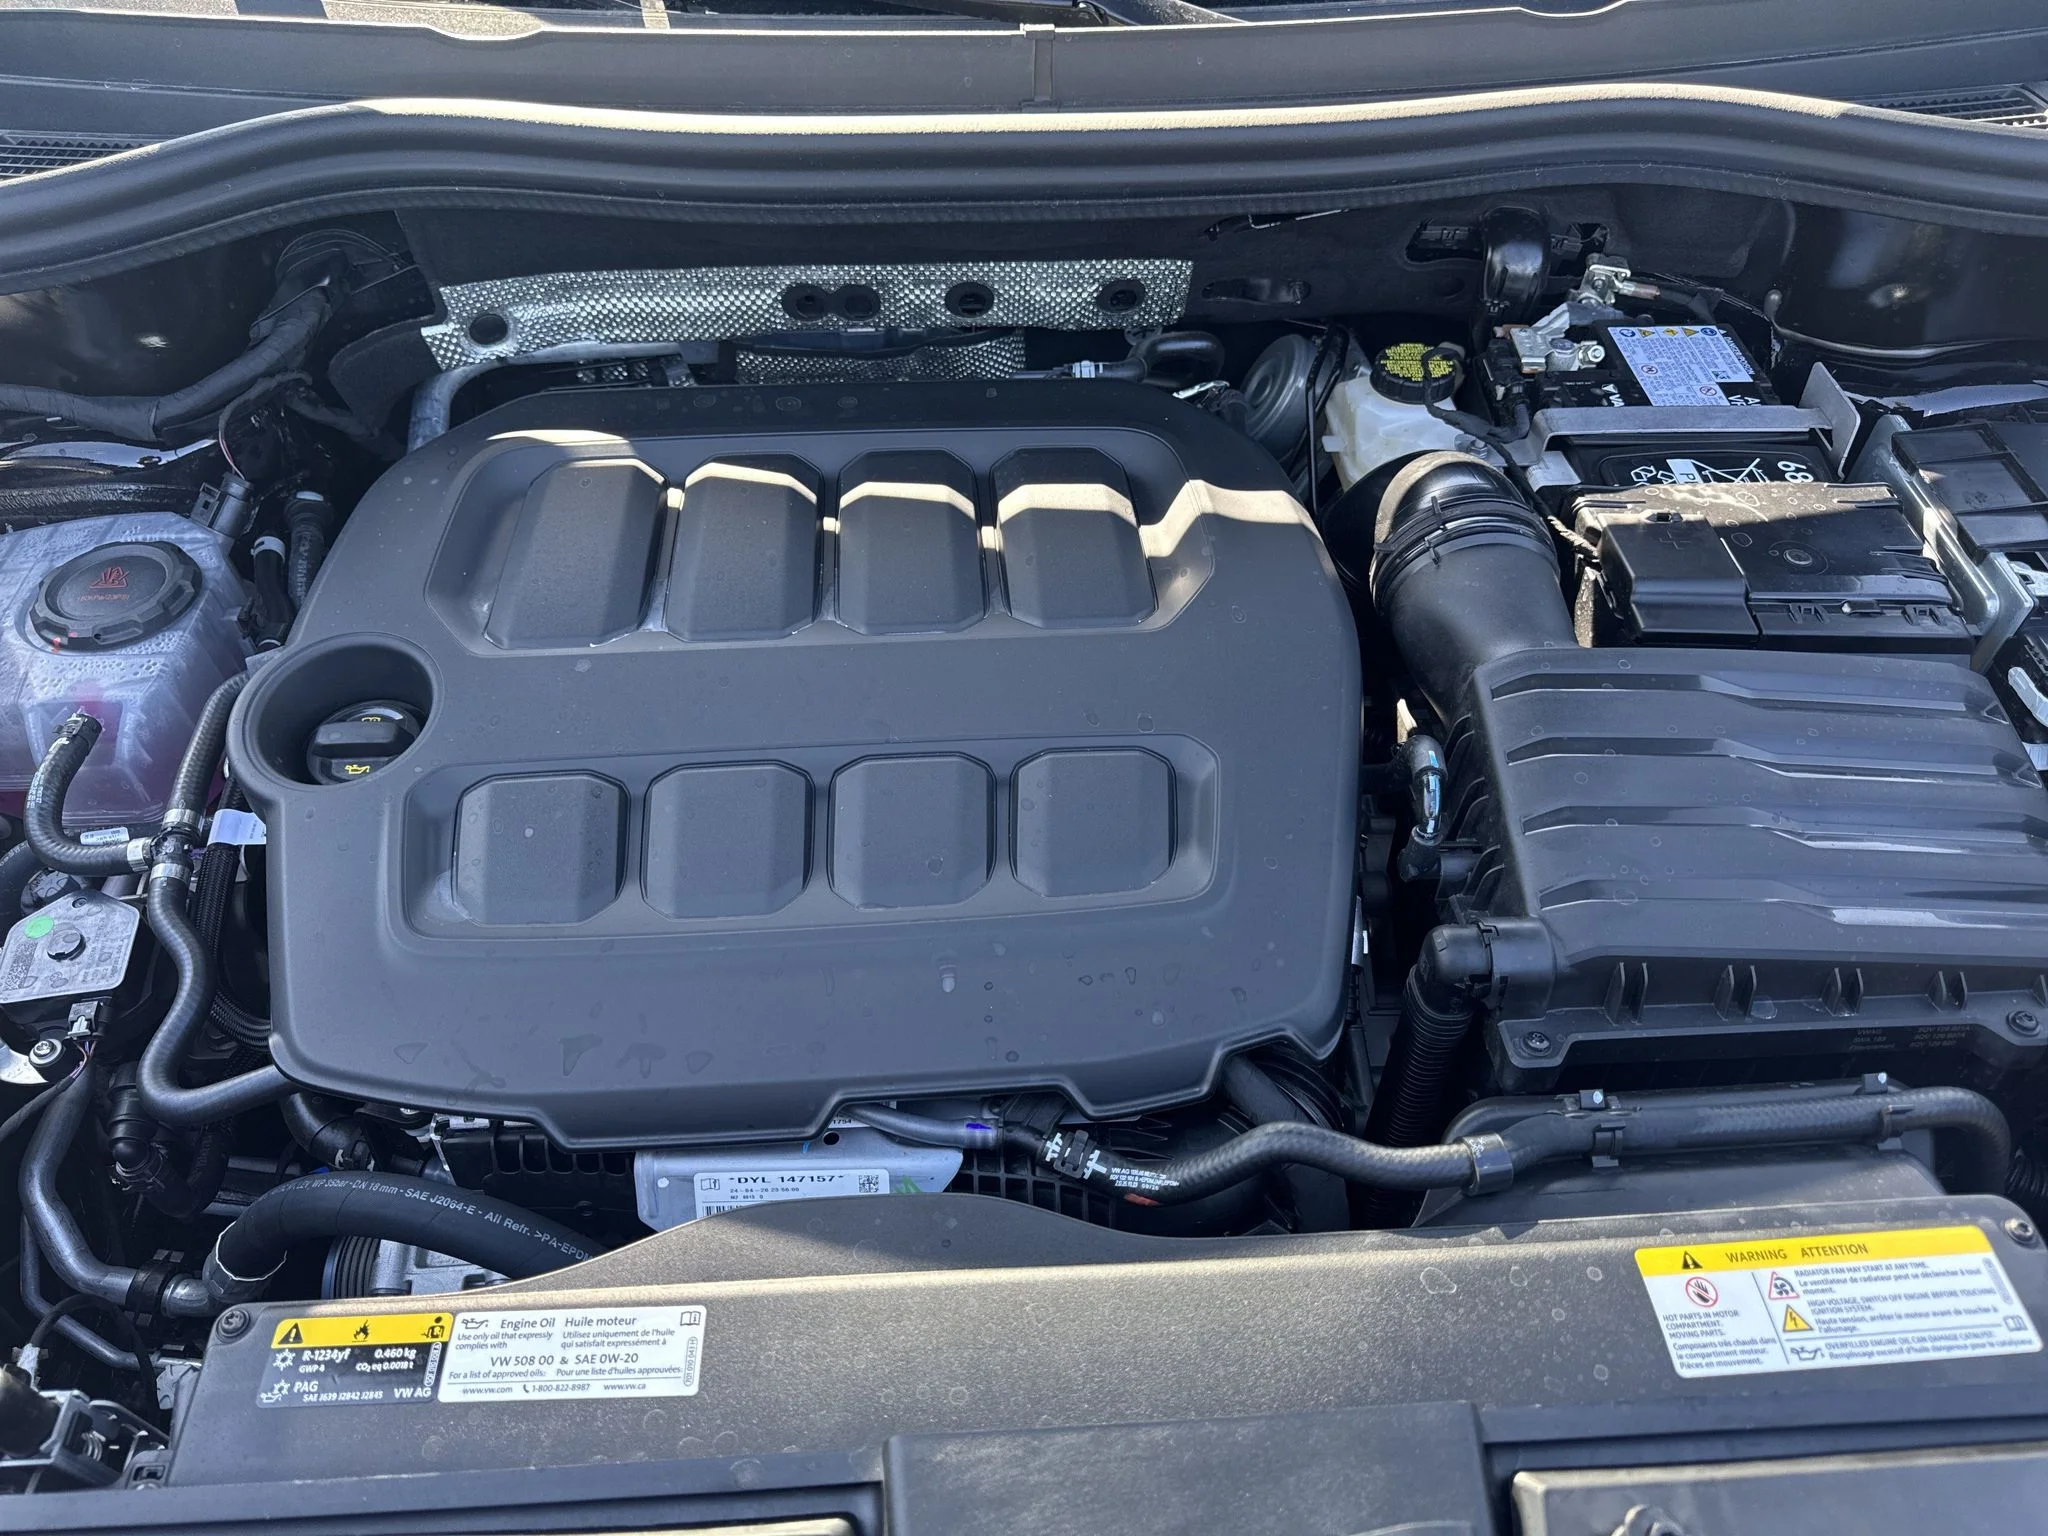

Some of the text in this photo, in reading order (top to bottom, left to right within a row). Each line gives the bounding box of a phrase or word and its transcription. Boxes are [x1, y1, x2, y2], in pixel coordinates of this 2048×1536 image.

[405, 1189, 430, 1200] SAE
[430, 1195, 476, 1215] J2064-E
[484, 1212, 501, 1225] All
[504, 1218, 530, 1236] Refr.
[1725, 1243, 1869, 1263] WARNING ATTENTION
[1794, 1268, 1830, 1276] RADIATOR
[1862, 1264, 1884, 1272] START
[1894, 1262, 1908, 1270] ANY
[1799, 1279, 1808, 1287] Le
[1809, 1278, 1847, 1286] ventilateur
[1859, 1275, 1891, 1283] radiateur
[1893, 1273, 1910, 1281] peut
[1807, 1299, 1825, 1307] HIGH
[1860, 1295, 1888, 1303] SWITCH
[1662, 1310, 1739, 1322] HOT PARTS IN MOTOR
[1810, 1307, 1843, 1315] IGNITION
[565, 1316, 637, 1327] Huile moteur
[1815, 1317, 1837, 1325] Haute
[1932, 1309, 1952, 1317] avant
[500, 1317, 555, 1331] Engine Oil
[1665, 1320, 1723, 1330] COMPARTMENT.
[473, 1333, 488, 1341] only
[491, 1332, 500, 1340] oil
[518, 1331, 552, 1341] expressly
[563, 1330, 590, 1338] Utilisez
[592, 1330, 638, 1339] uniquement
[652, 1328, 675, 1336] l'huile
[1669, 1328, 1726, 1339] MOVING PARTS.
[561, 1340, 573, 1349] qui
[575, 1339, 605, 1348] satisfait
[607, 1338, 659, 1348] expressément
[1673, 1336, 1776, 1352] Composants très chauds dans
[1870, 1338, 1896, 1346] ENGINE
[1911, 1335, 1927, 1343] CAN
[455, 1342, 488, 1351] complies
[302, 1349, 351, 1364] R-1234yf
[374, 1348, 416, 1359] 0.460 kg
[1676, 1348, 1769, 1360] le compartiment moteur.
[491, 1353, 638, 1366] VW 508 00 & SAE 0W-20
[1680, 1357, 1763, 1369] Pièces en mouvement.
[299, 1364, 325, 1373] GWP 4
[482, 1370, 491, 1378] of
[492, 1369, 528, 1379] approved
[608, 1366, 636, 1375] d'huiles
[293, 1381, 318, 1393] PAG
[394, 1387, 432, 1398] VW AG
[532, 1384, 590, 1392] 1-800-822-8987
[303, 1393, 318, 1402] SAE
